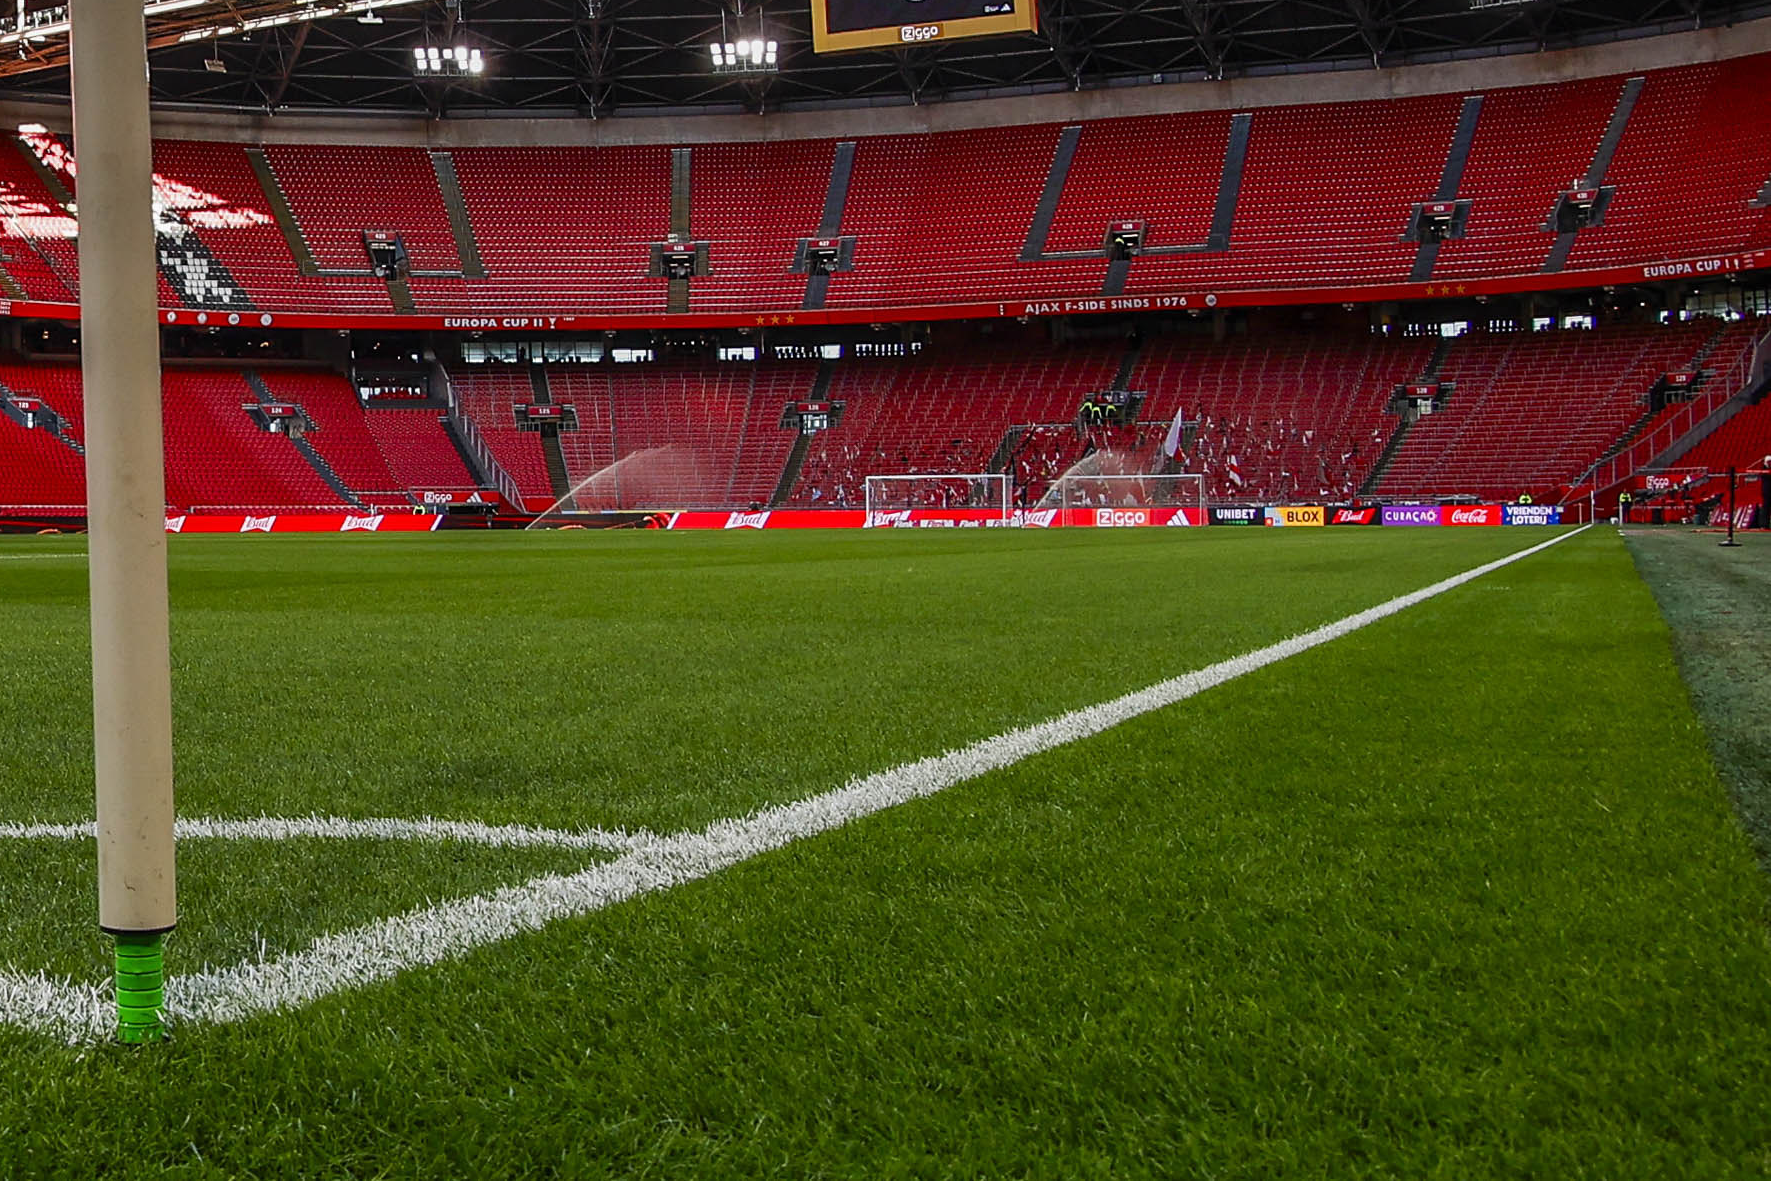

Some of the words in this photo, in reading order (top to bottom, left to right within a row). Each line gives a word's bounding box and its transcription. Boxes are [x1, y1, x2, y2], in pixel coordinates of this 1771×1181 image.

[1643, 263, 1692, 277] EUROPA
[1696, 260, 1721, 271] CUP
[1025, 303, 1060, 315] AJAX
[1065, 300, 1105, 311] F-SIDE
[1111, 298, 1149, 309] SINDS
[1156, 297, 1187, 306] 1976
[444, 318, 497, 327] EUROPA
[503, 318, 529, 327] CUP
[533, 318, 543, 327] II
[1216, 509, 1256, 519] UNIBET
[1338, 509, 1364, 521] Bud
[1506, 506, 1553, 515] VRIENDEN
[1287, 511, 1319, 522] BLOX
[1512, 515, 1547, 524] LOTERIJ
